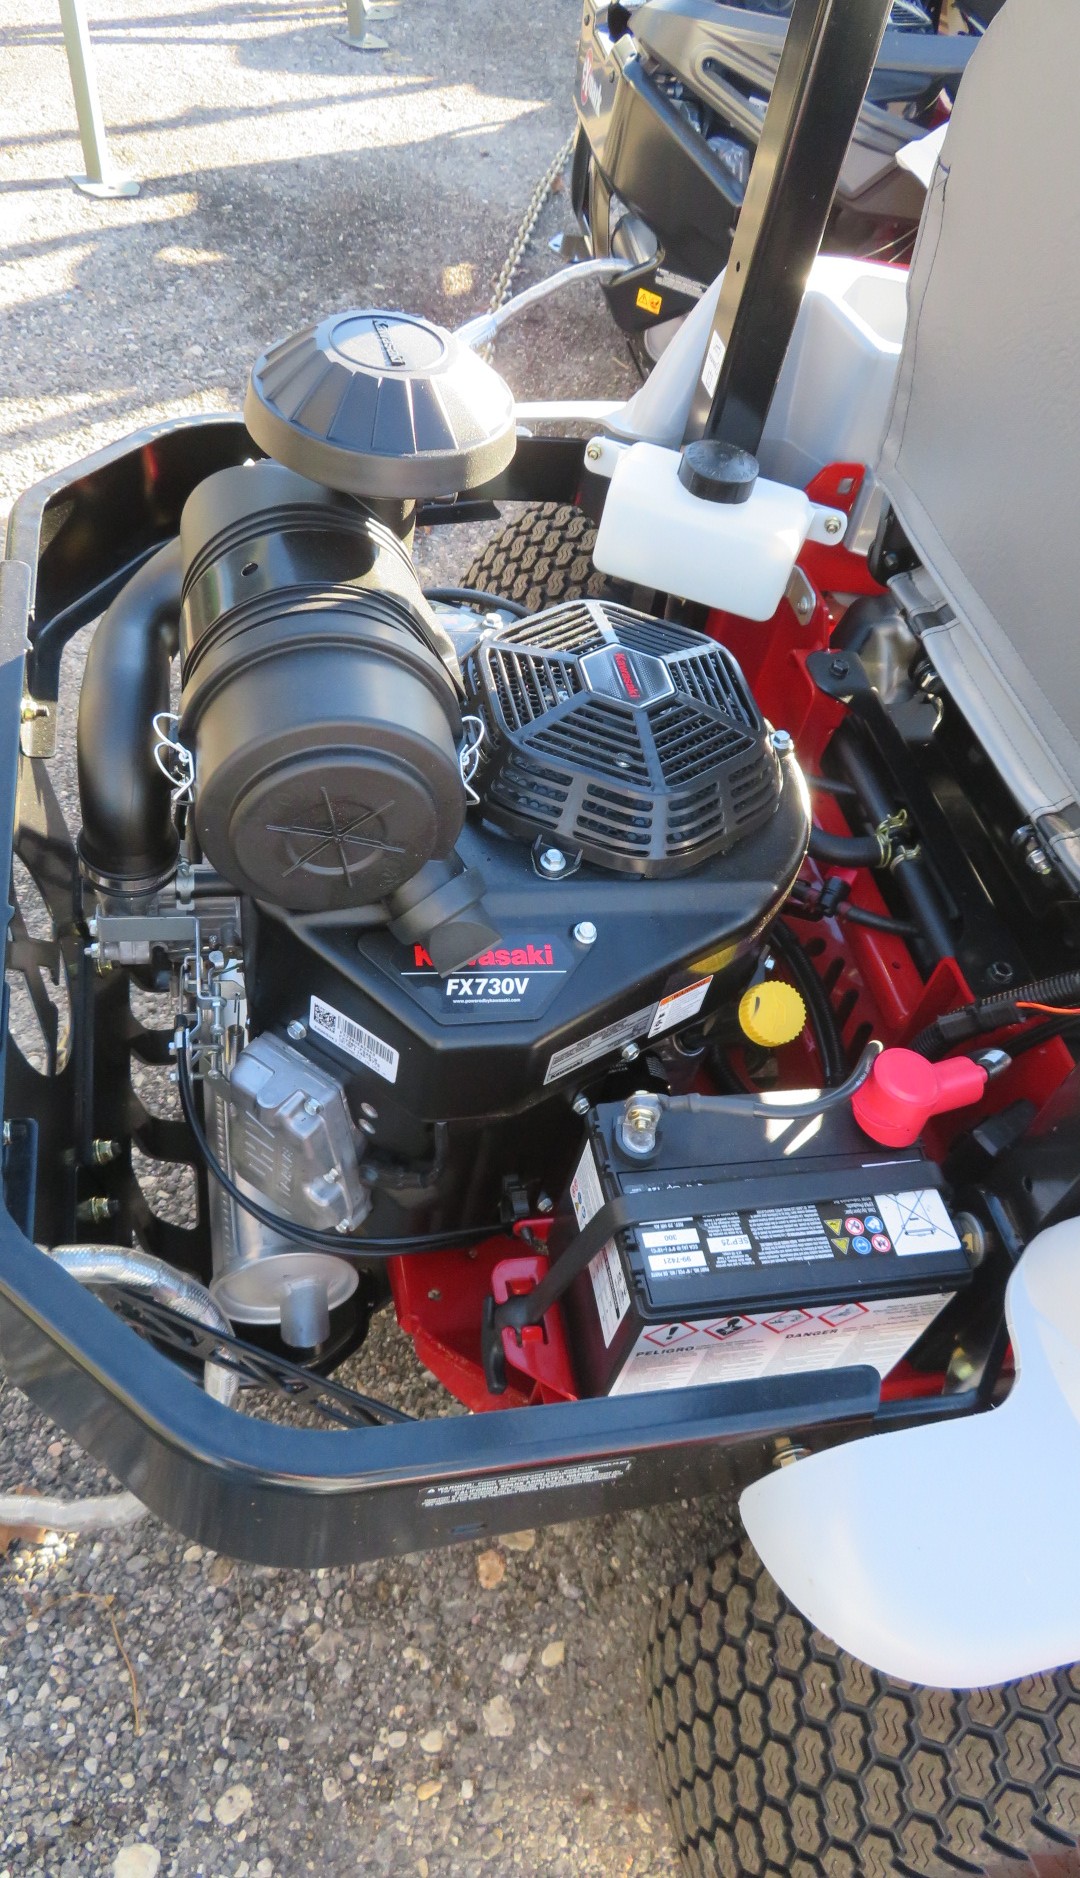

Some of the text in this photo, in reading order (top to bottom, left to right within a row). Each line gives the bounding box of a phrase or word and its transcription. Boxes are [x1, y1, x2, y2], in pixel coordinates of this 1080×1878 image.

[613, 652, 641, 698] Kawasaki
[413, 944, 554, 967] Kasaki
[446, 977, 530, 996] FX730V
[663, 1234, 677, 1242] 300
[663, 1255, 692, 1265] 99-7421
[785, 1328, 839, 1340] DANGER
[635, 1345, 695, 1358] PELIGRO
